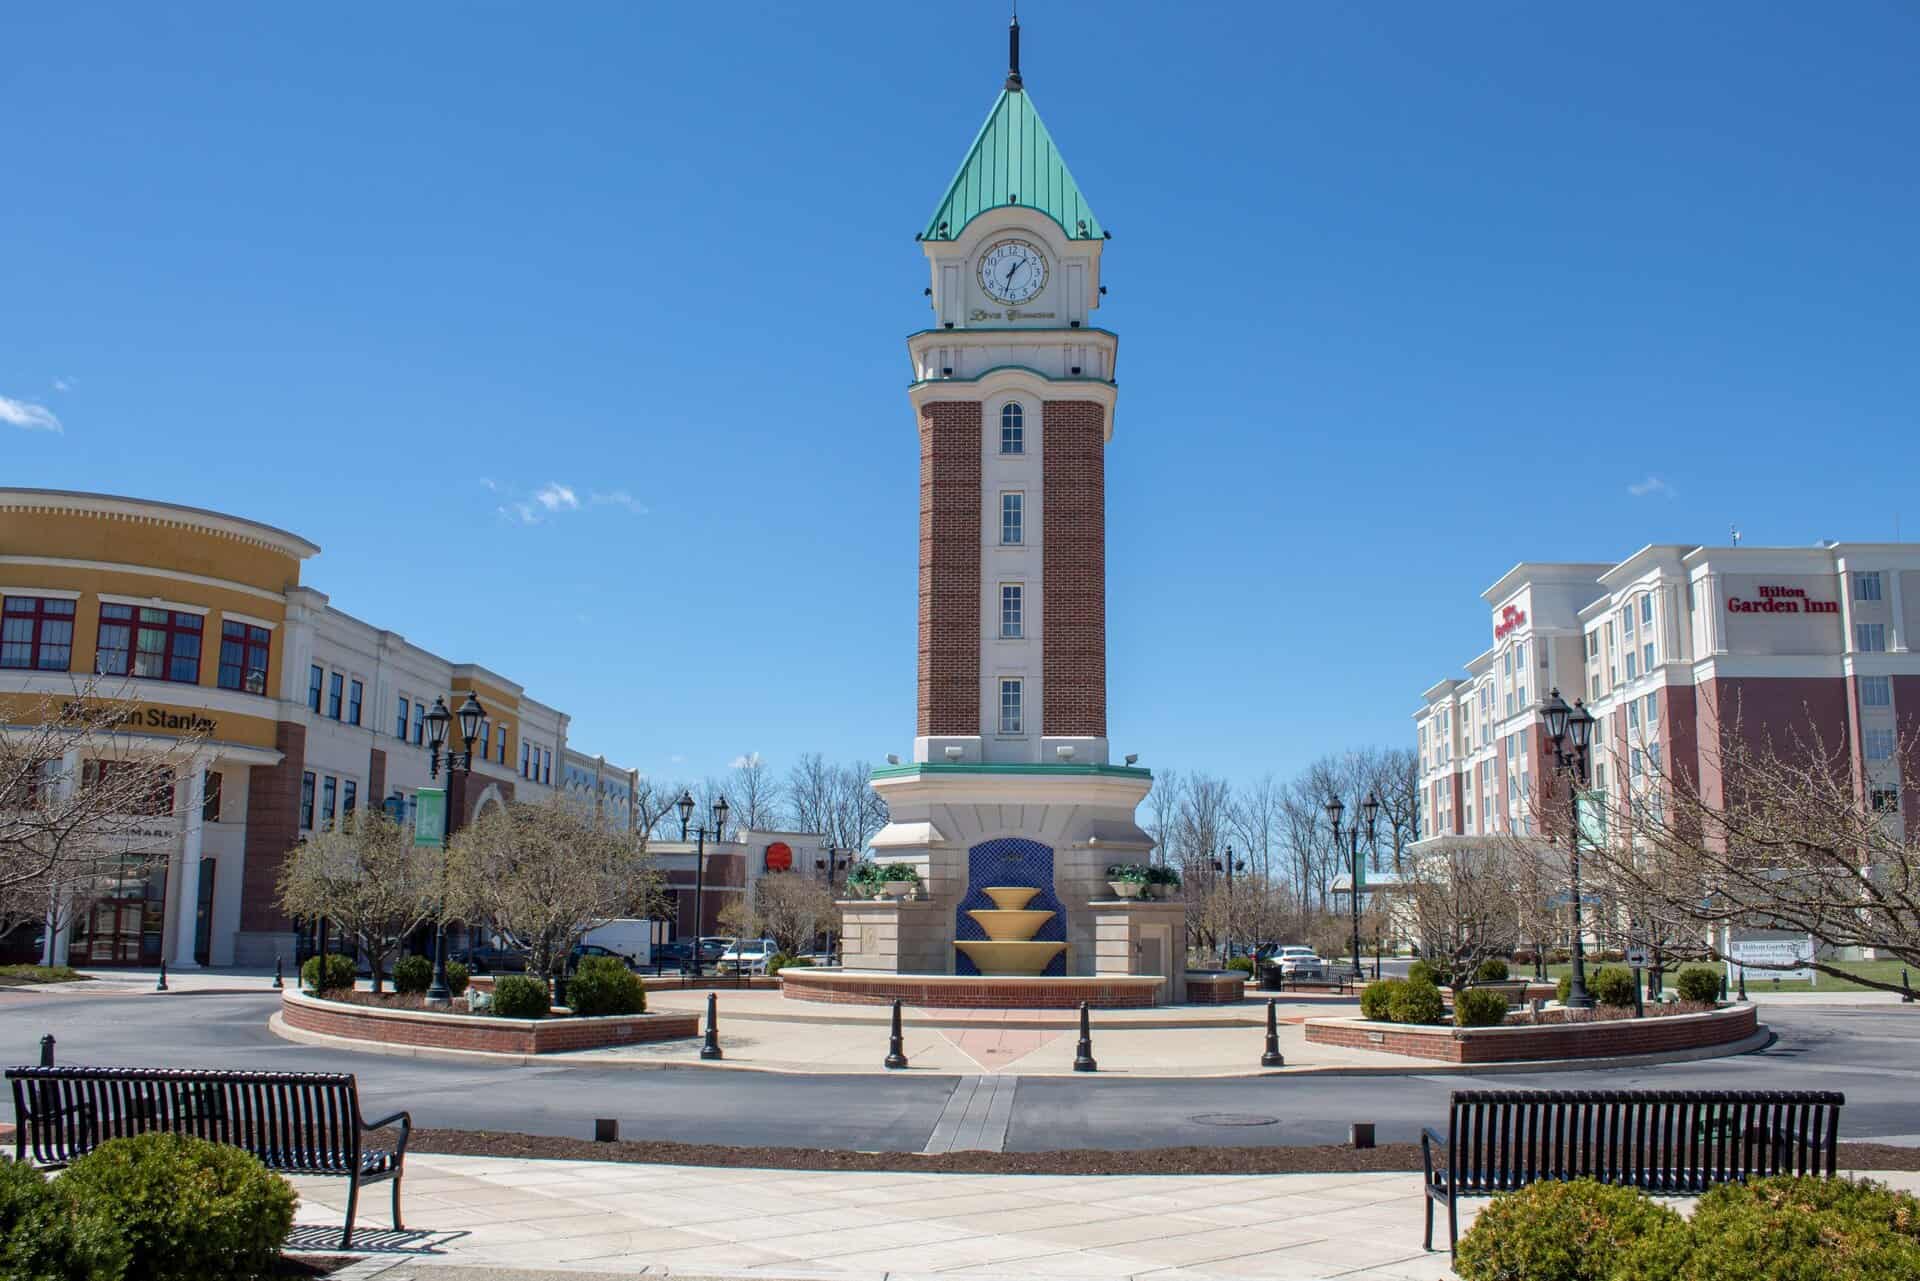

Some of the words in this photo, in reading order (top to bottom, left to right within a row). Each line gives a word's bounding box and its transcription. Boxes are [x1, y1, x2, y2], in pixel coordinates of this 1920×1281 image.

[1008, 245, 1018, 256] 12
[987, 257, 997, 266] 10
[1758, 586, 1805, 598] Hilton
[1728, 598, 1800, 613] Garden
[1804, 598, 1839, 613] Inn
[147, 708, 217, 732] Stanley
